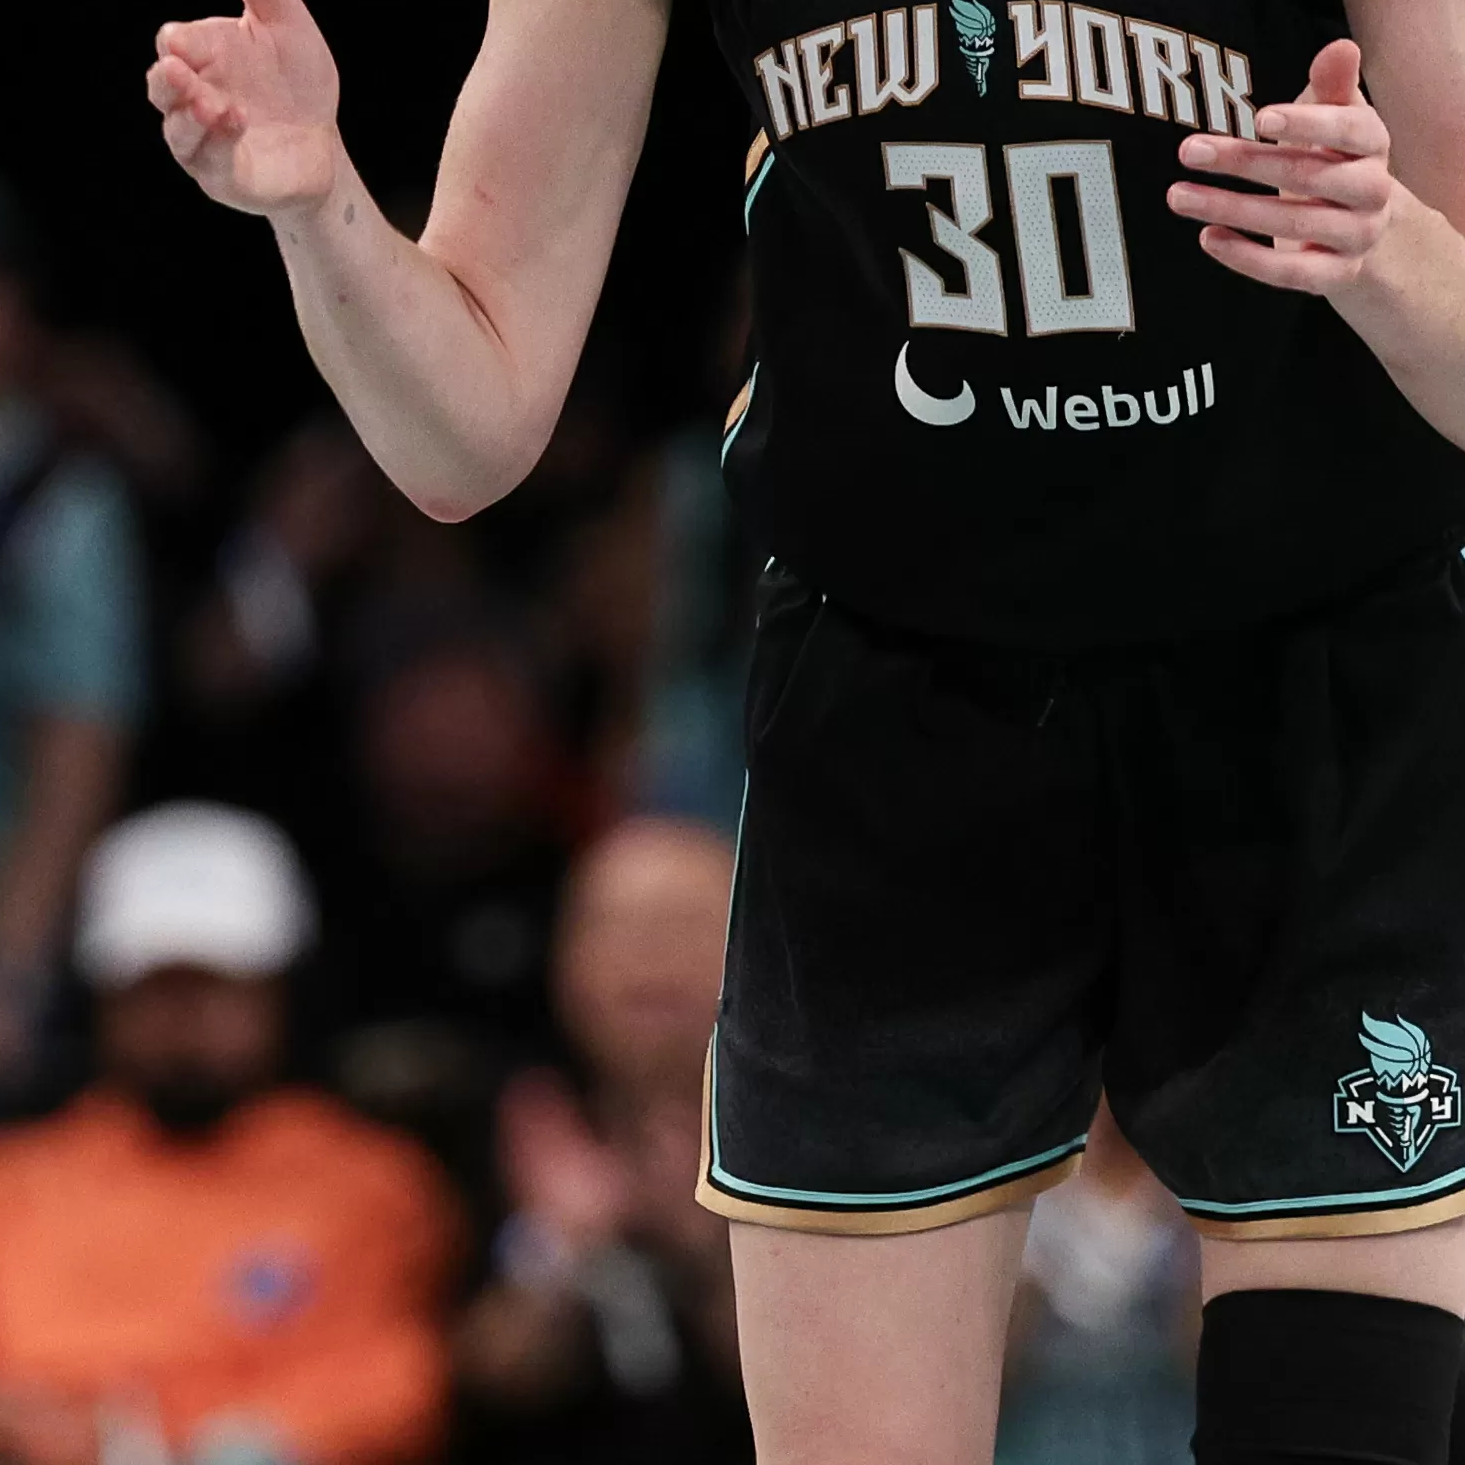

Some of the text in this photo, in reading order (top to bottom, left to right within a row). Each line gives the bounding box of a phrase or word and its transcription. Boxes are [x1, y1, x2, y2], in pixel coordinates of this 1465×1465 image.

[754, 0, 1259, 142] NEW YORK
[881, 140, 1136, 338] 30
[1000, 362, 1215, 431] Webull
